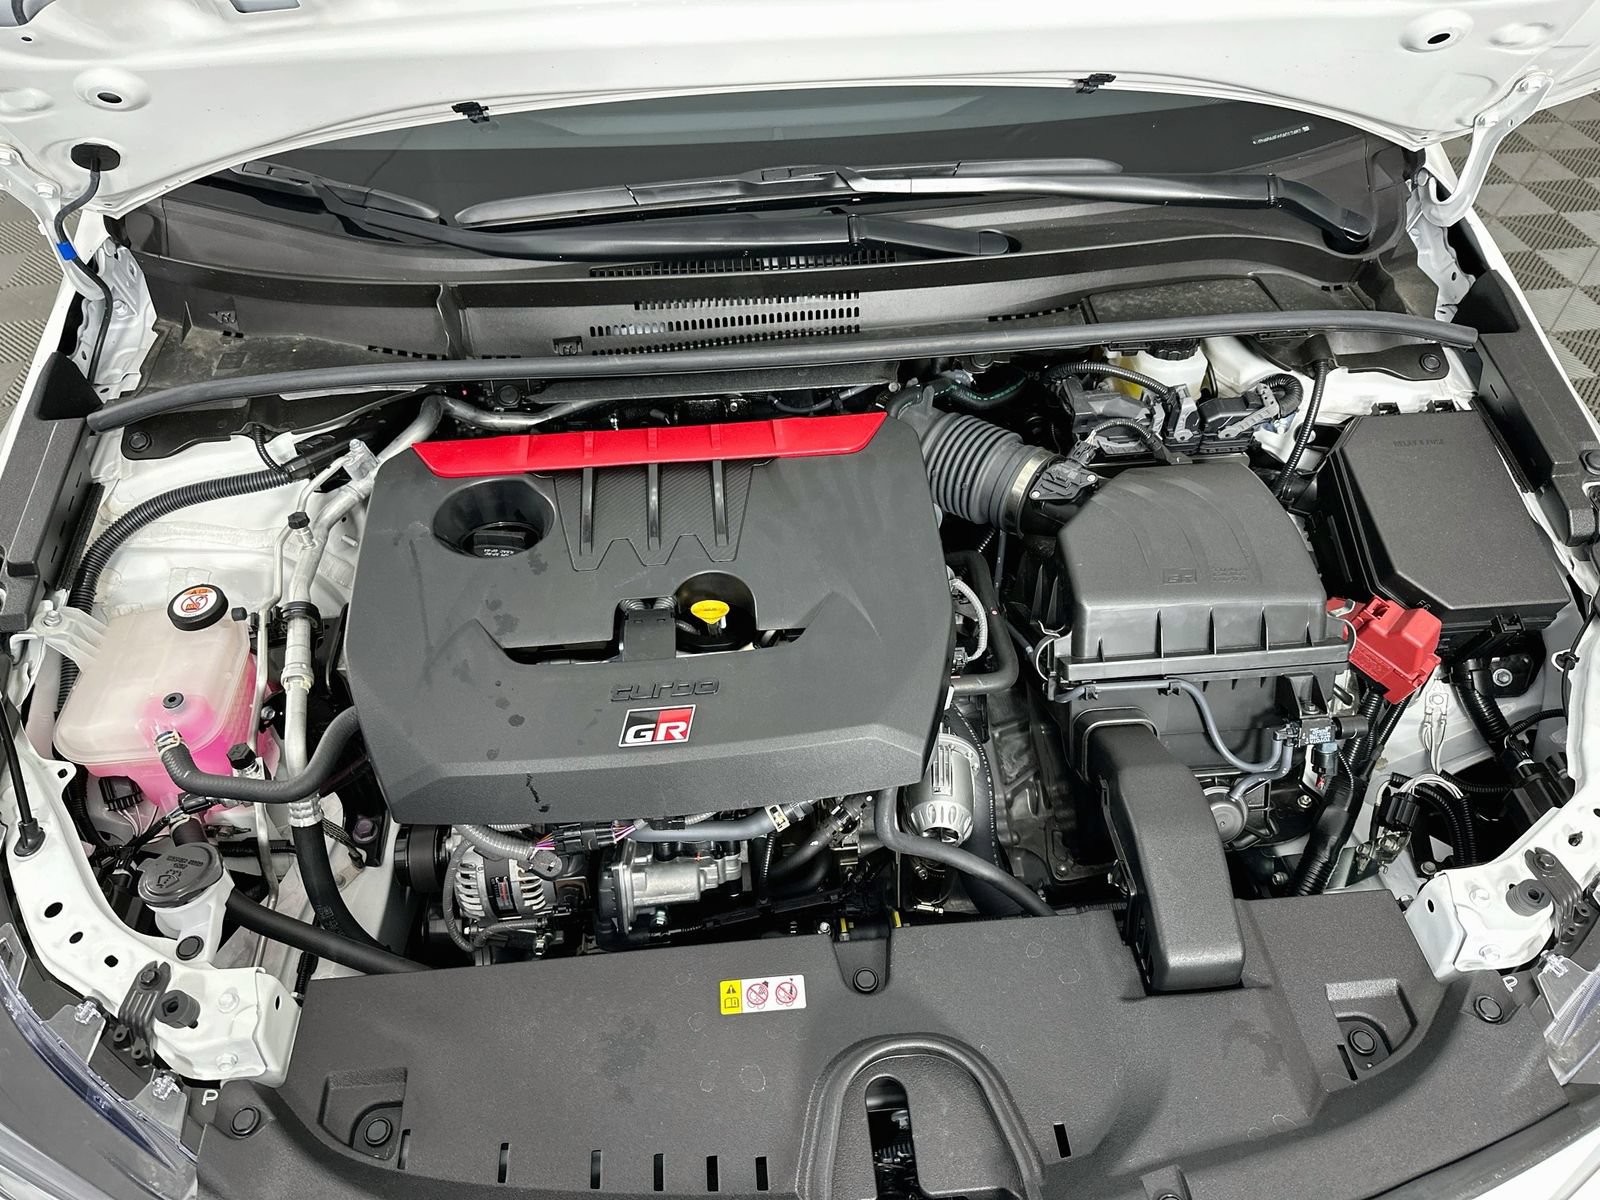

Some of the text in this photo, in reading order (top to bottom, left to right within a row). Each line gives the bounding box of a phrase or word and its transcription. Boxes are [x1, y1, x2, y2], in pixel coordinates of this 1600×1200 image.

[624, 721, 688, 744] GR
[1502, 975, 1519, 993] P
[201, 1089, 219, 1106] P
